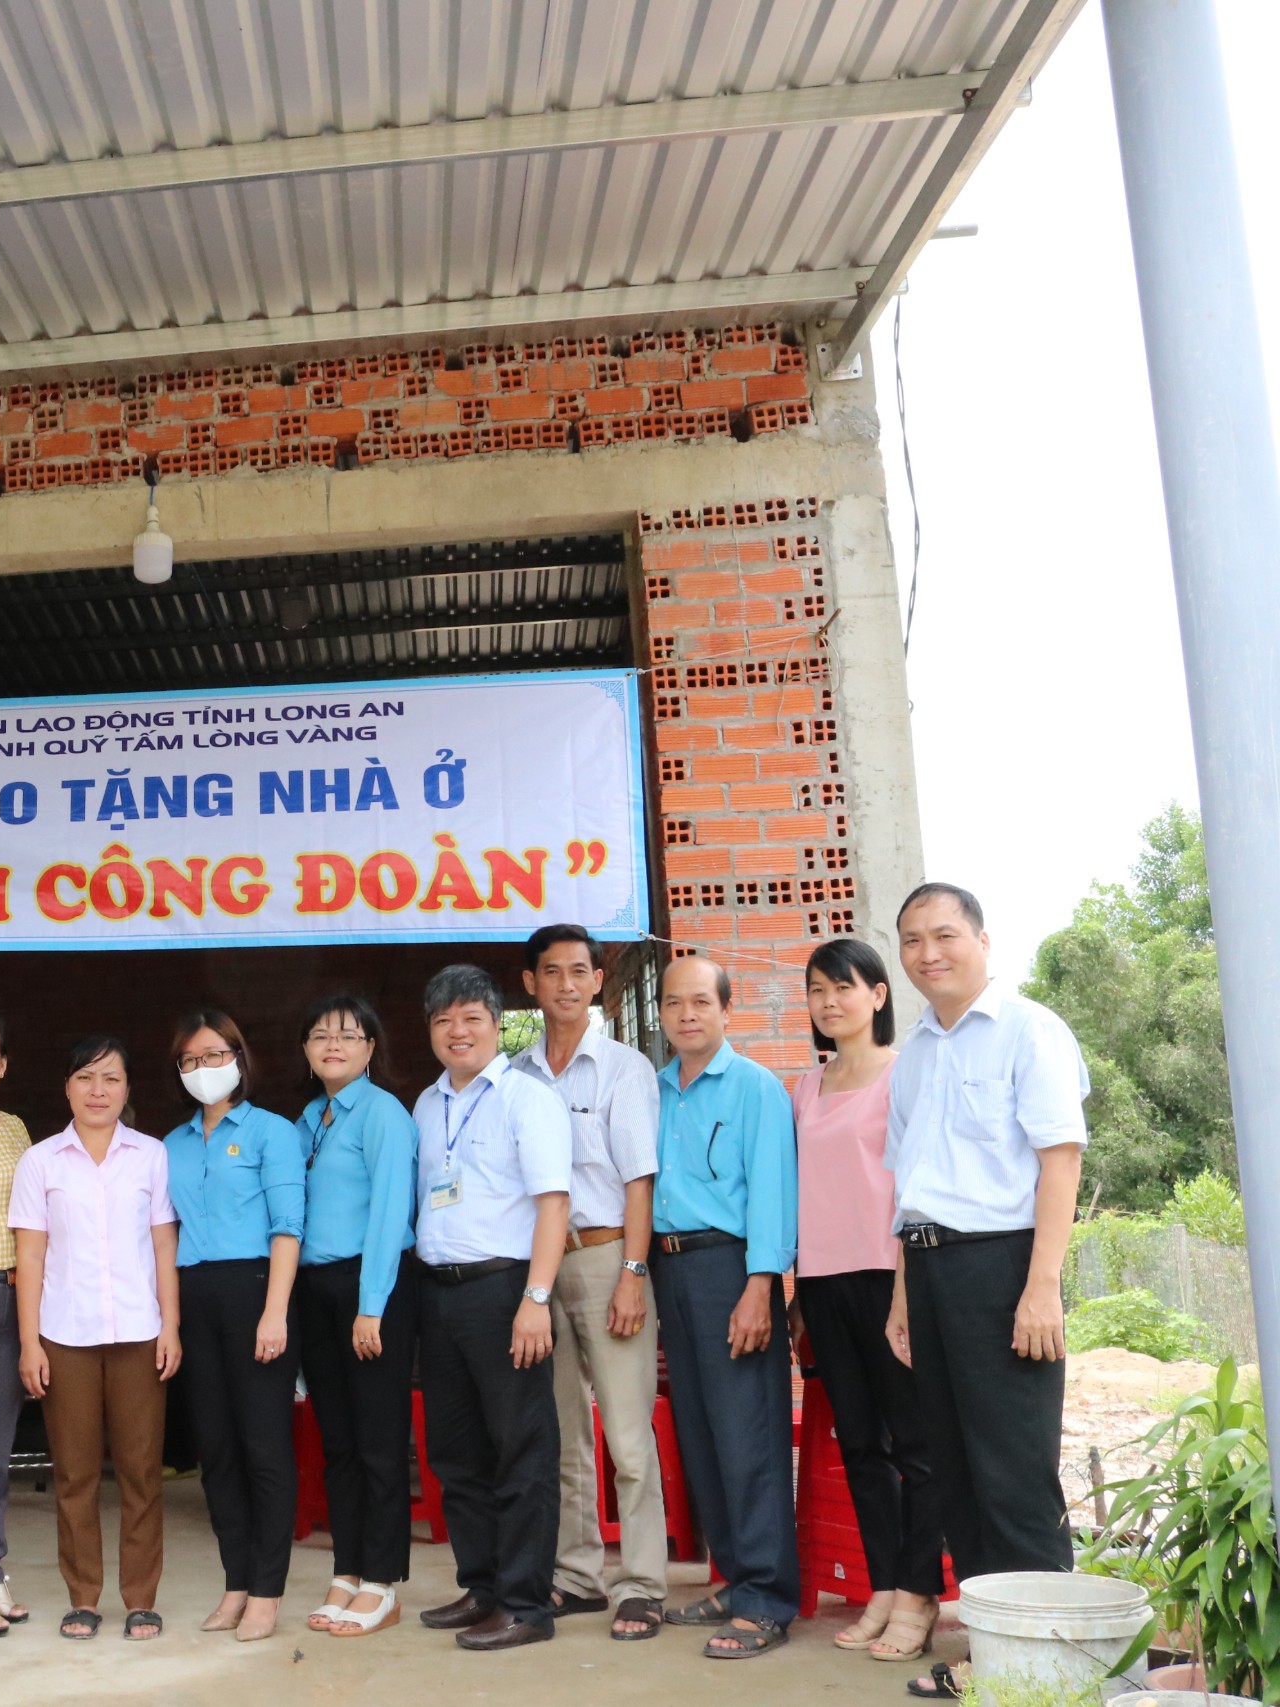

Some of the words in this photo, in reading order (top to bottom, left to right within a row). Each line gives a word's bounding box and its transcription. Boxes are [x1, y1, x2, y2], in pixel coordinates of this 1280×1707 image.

[16, 716, 76, 733] LAO
[83, 710, 174, 732] ĐỘNG
[182, 706, 255, 725] TỈNH
[265, 703, 351, 721] LONG
[358, 701, 404, 717] AN
[44, 734, 109, 755] QUỸ
[115, 729, 183, 752] TẤM
[193, 729, 279, 748] LÒNG
[286, 725, 377, 744] VÀNG
[61, 768, 234, 831] TẶNG
[259, 757, 400, 815] NHÀ
[423, 748, 467, 810] Ở
[34, 841, 271, 923] CÔNG
